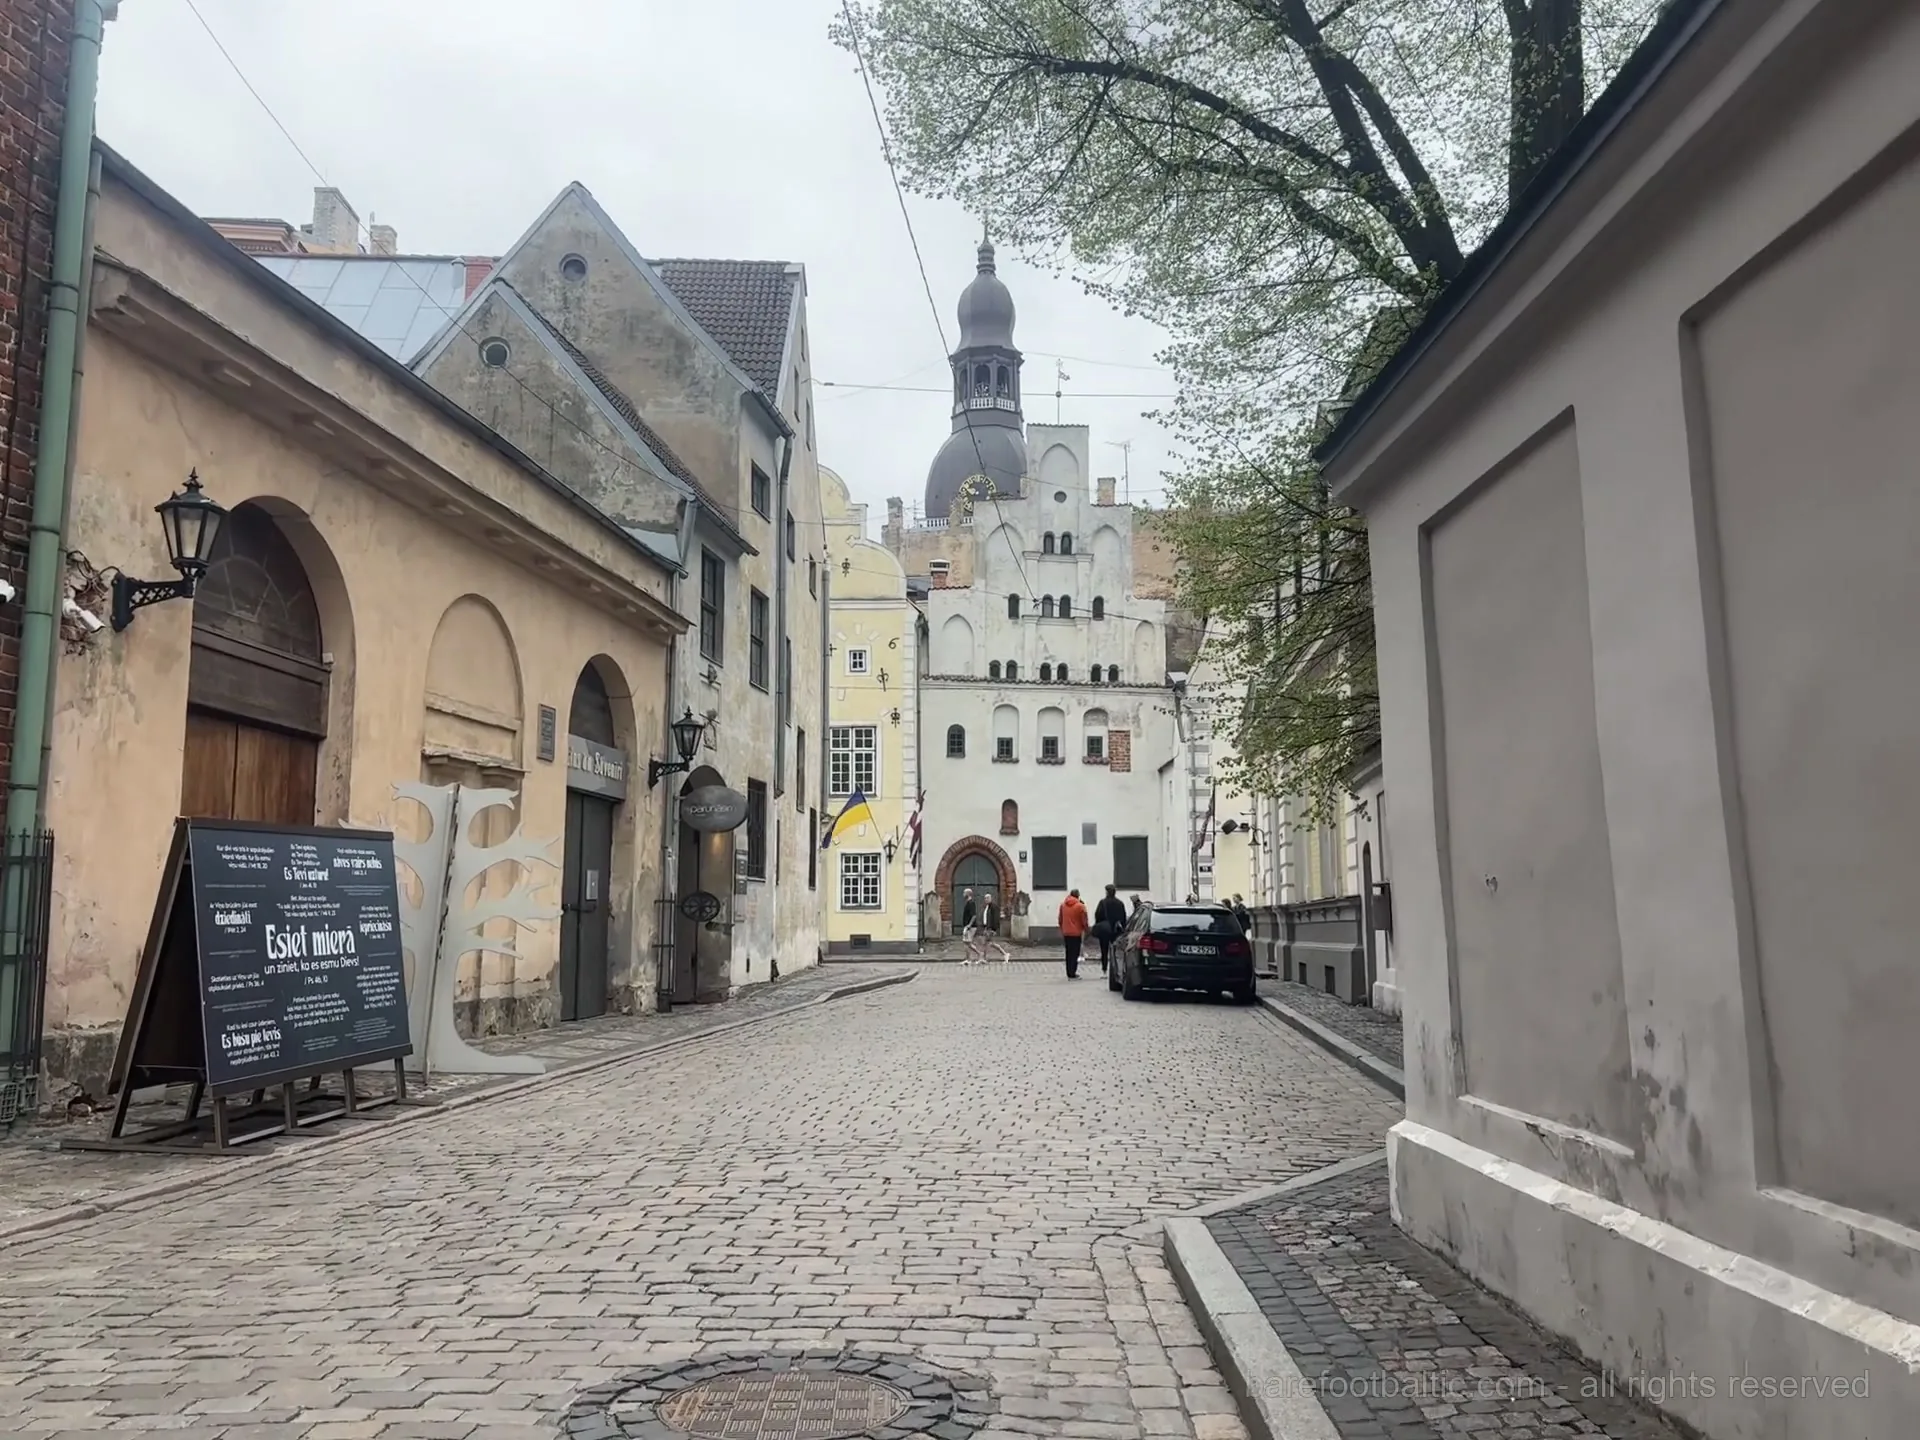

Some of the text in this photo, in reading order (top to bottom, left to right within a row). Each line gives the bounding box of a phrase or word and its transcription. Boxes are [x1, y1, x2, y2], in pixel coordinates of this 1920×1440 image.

[265, 924, 356, 960] Esiet mierā
[264, 956, 360, 975] un ziniet, ka es esmu Dievs!
[222, 1034, 232, 1049] Es
